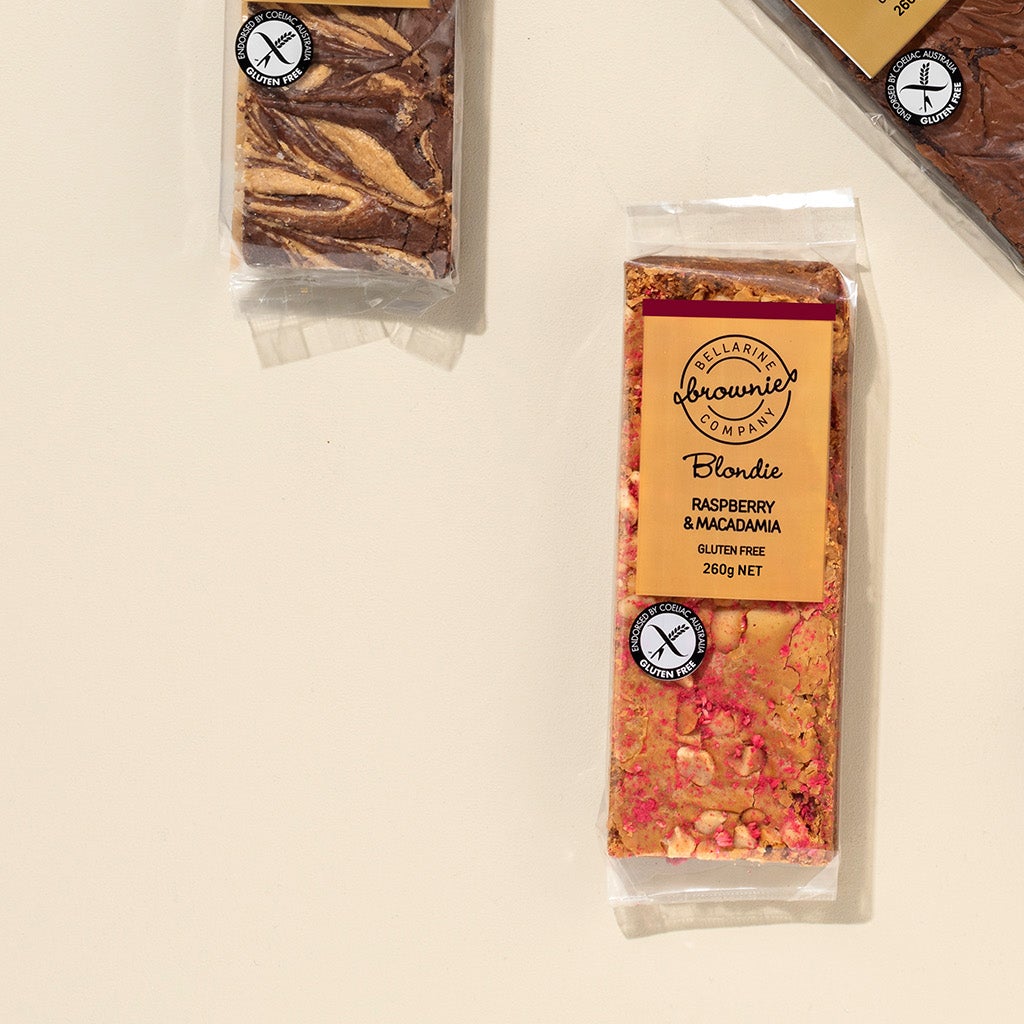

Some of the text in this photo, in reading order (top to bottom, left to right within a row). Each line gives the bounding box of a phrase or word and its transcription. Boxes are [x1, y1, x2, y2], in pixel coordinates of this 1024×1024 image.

[237, 11, 311, 61] ENDORSED BY COELIAC AUSTRALIA
[246, 67, 302, 86] GLUTEN FREE
[888, 51, 957, 121] ENDORSED BY COELIAC AUSTRALIA
[920, 82, 961, 124] GLUTEN FREE
[695, 342, 776, 371] BELLARINE
[682, 375, 789, 404] brownie
[700, 407, 775, 436] COMPANY
[683, 452, 783, 479] Blondie
[692, 498, 775, 513] RASPBERRY
[684, 517, 781, 533] & MACADAMIA
[698, 544, 765, 556] GLUTEN FREE
[703, 563, 762, 578] 260g NET
[631, 604, 705, 654] ENDORSED BY COELIAC AUSTRALIA
[640, 659, 696, 678] GLUTEN FREE
